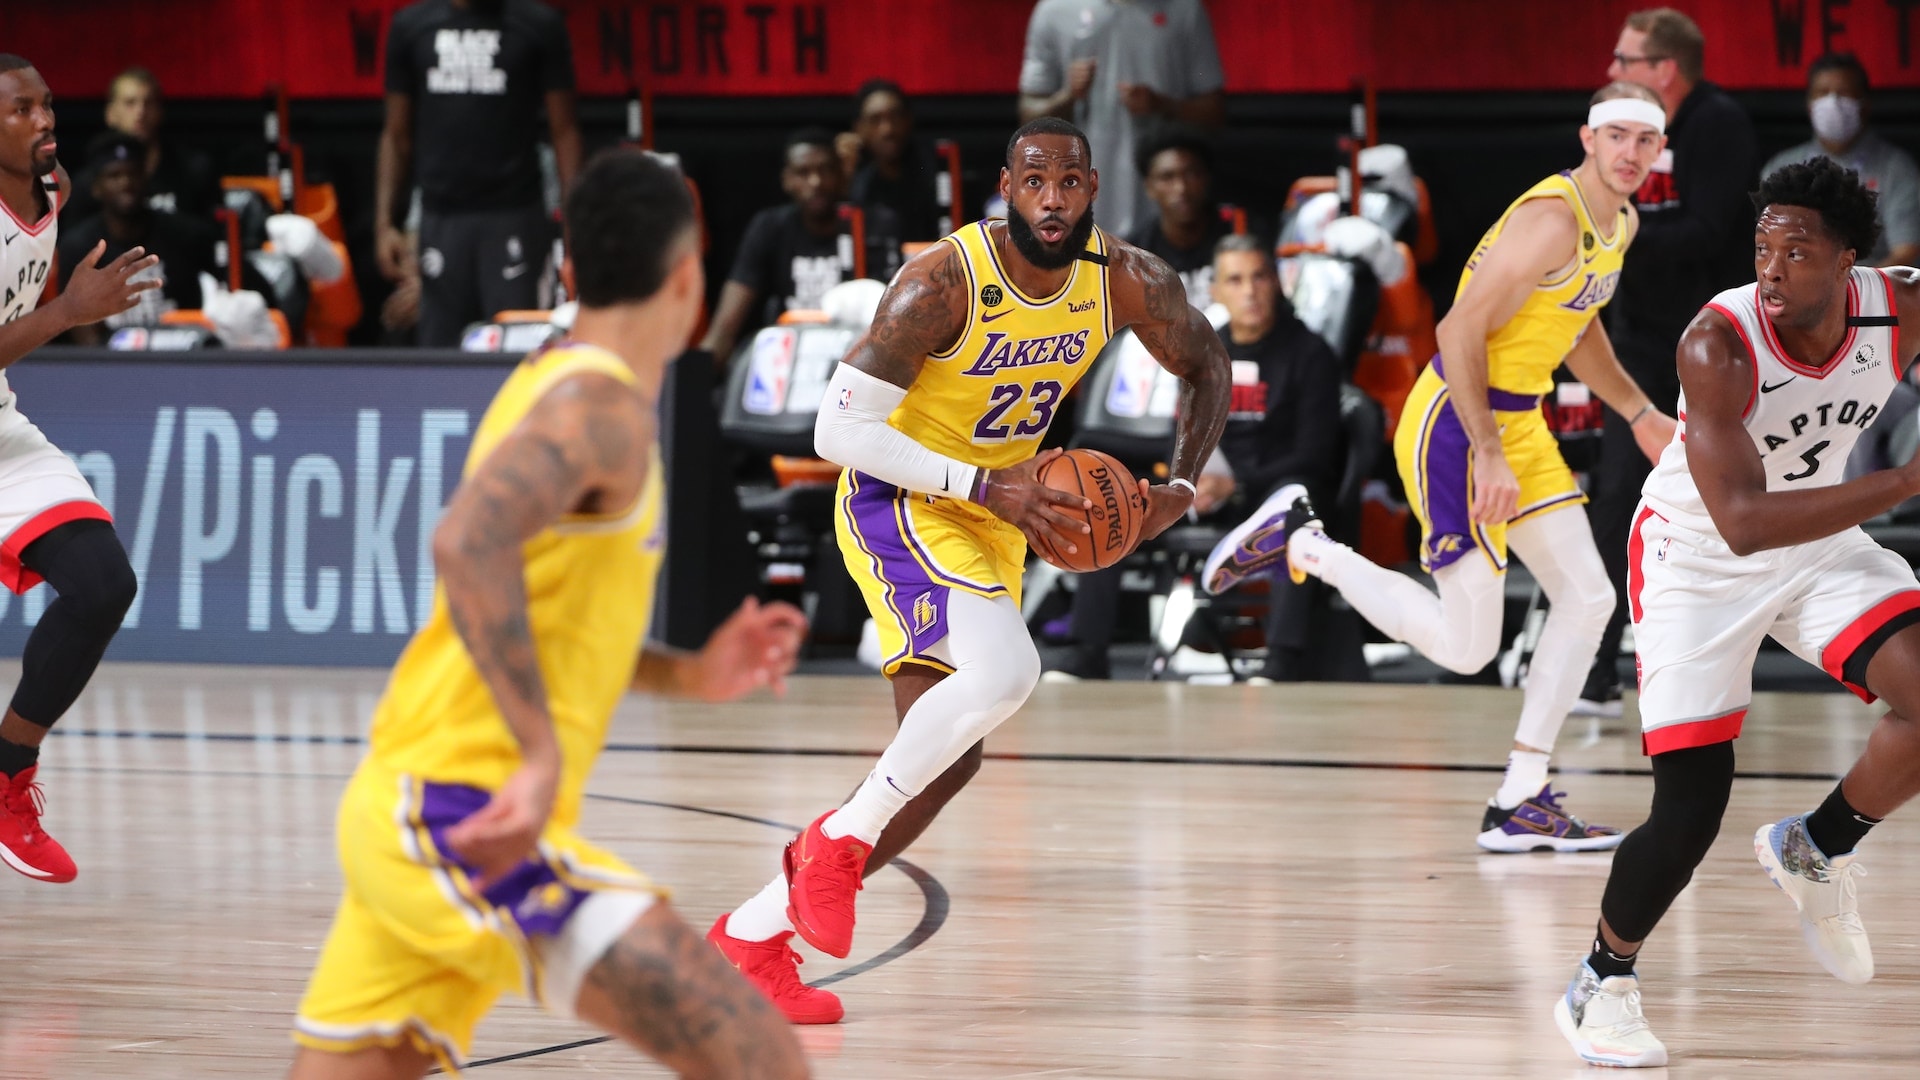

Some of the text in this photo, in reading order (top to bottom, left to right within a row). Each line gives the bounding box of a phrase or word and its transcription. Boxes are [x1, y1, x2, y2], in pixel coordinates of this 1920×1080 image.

[603, 6, 829, 76] NORTH
[1771, 0, 1852, 68] WE
[4, 259, 48, 308] APTO
[1068, 299, 1096, 313] wish
[961, 329, 1090, 376] LAKERS
[1850, 359, 1882, 376] Sun Life
[973, 380, 1063, 438] 23
[1761, 400, 1878, 457] APTOR
[1783, 440, 1831, 481] 5
[1088, 465, 1123, 551] SPALDING
